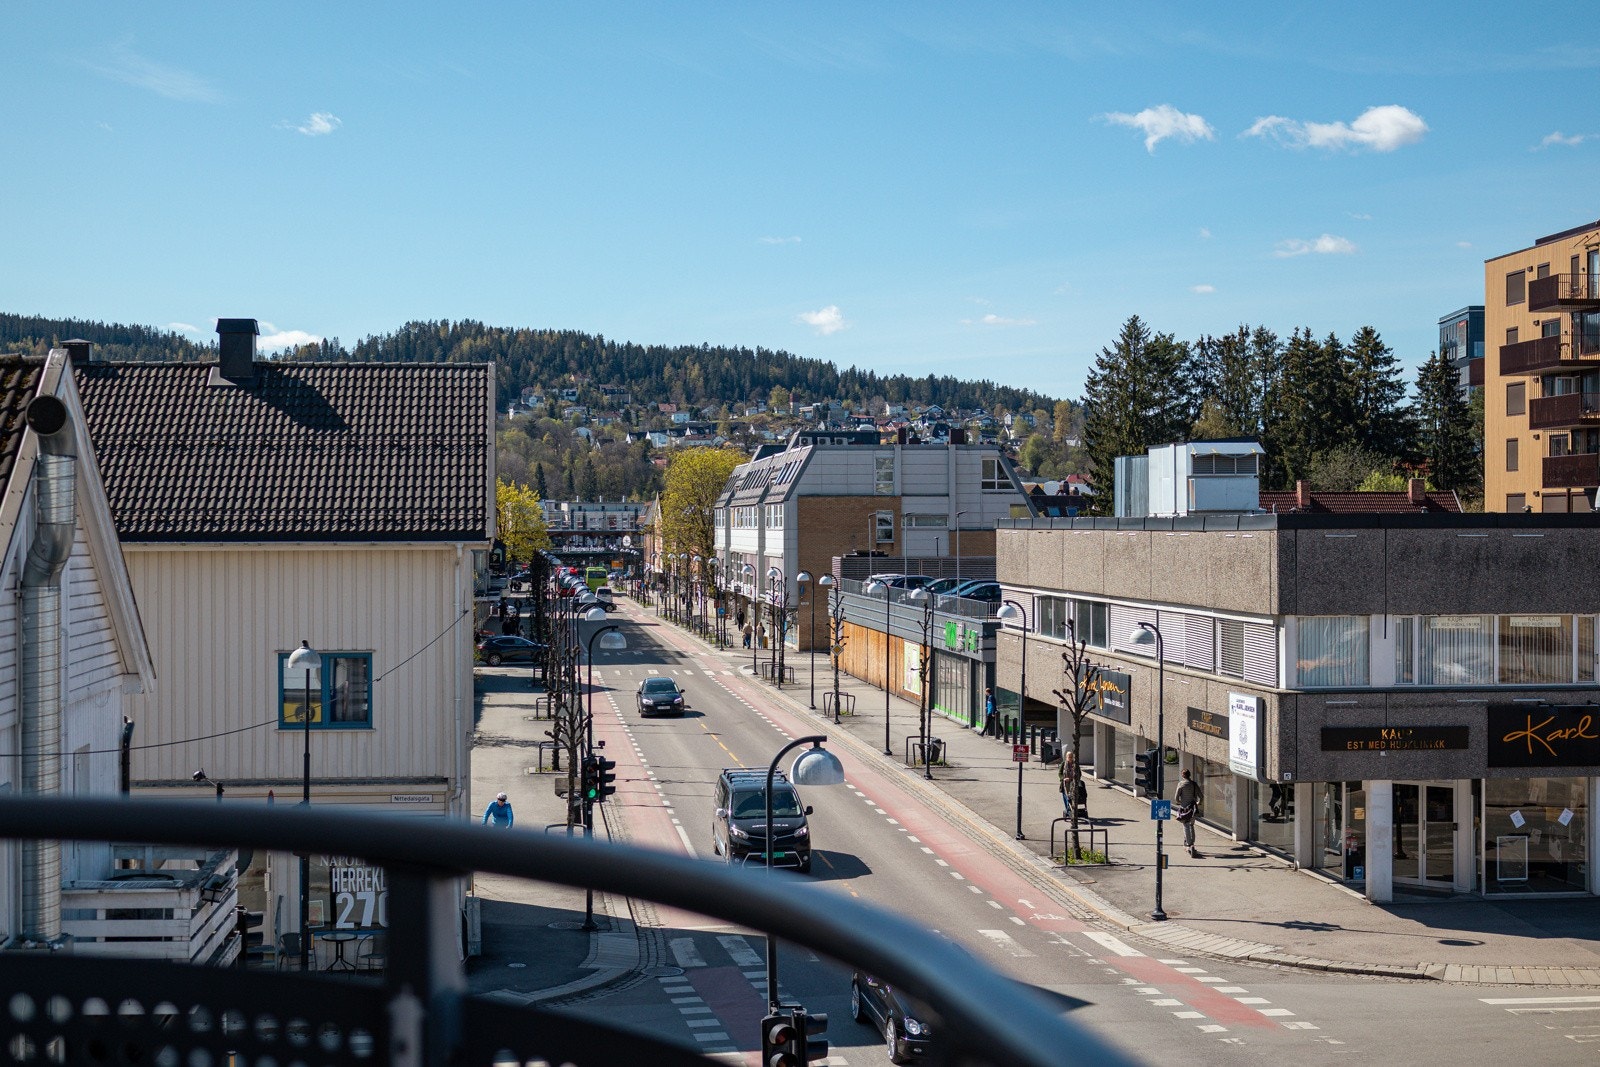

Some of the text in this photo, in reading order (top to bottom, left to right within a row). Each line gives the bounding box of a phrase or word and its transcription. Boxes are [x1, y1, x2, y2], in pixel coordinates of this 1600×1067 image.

[1347, 741, 1364, 749] EST
[1368, 741, 1386, 749] MED
[1502, 714, 1598, 756] Karl
